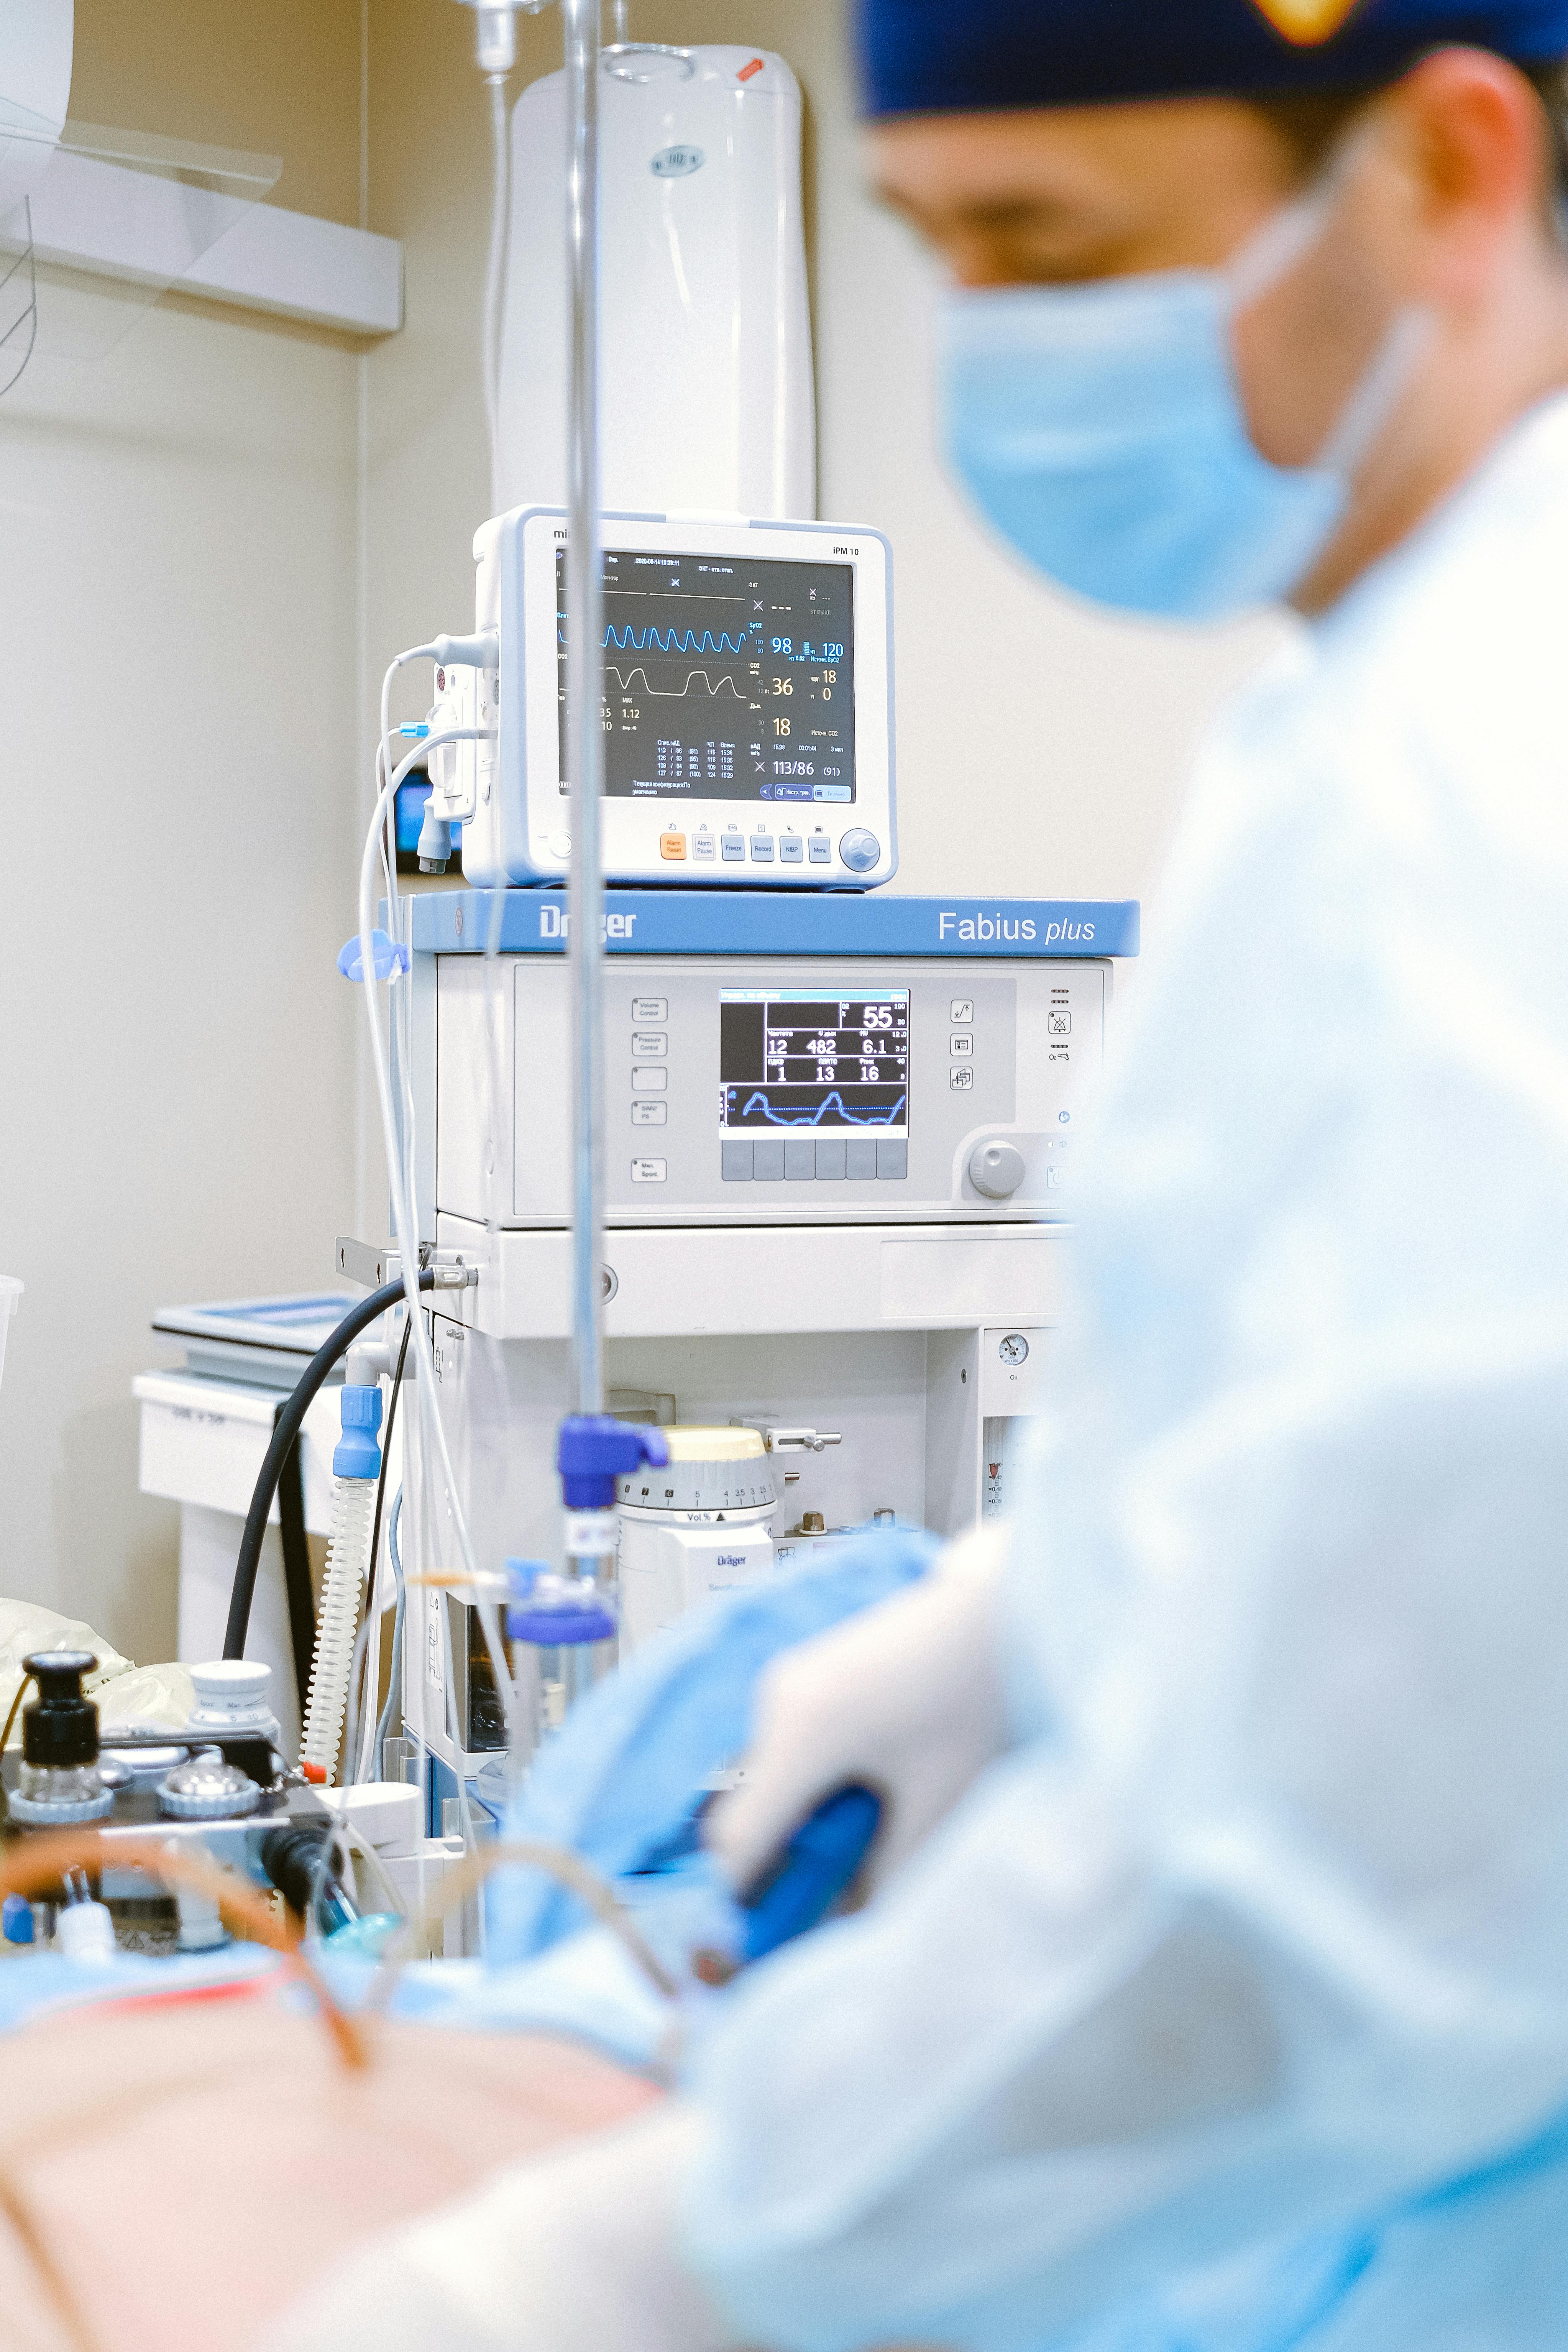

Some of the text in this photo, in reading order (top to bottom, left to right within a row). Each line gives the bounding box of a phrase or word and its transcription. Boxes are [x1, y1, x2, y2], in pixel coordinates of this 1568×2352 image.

[772, 637, 792, 654] 98
[823, 643, 844, 657] 120
[823, 670, 836, 683] 18
[773, 677, 793, 695] 36
[823, 687, 831, 701] 0
[622, 709, 640, 719] 1.12
[773, 718, 791, 736] 18
[773, 761, 814, 775] 113/86
[823, 767, 840, 776] (91)
[540, 905, 637, 944] Drer
[939, 912, 1095, 946] Fabius plus
[864, 1006, 893, 1028] 55
[768, 1039, 788, 1054] 12
[806, 1039, 836, 1054] 482
[863, 1039, 887, 1054] 6.1
[778, 1066, 787, 1082] 1
[816, 1066, 835, 1081] 13
[861, 1066, 879, 1081] 16
[718, 1555, 745, 1566] Dräger
